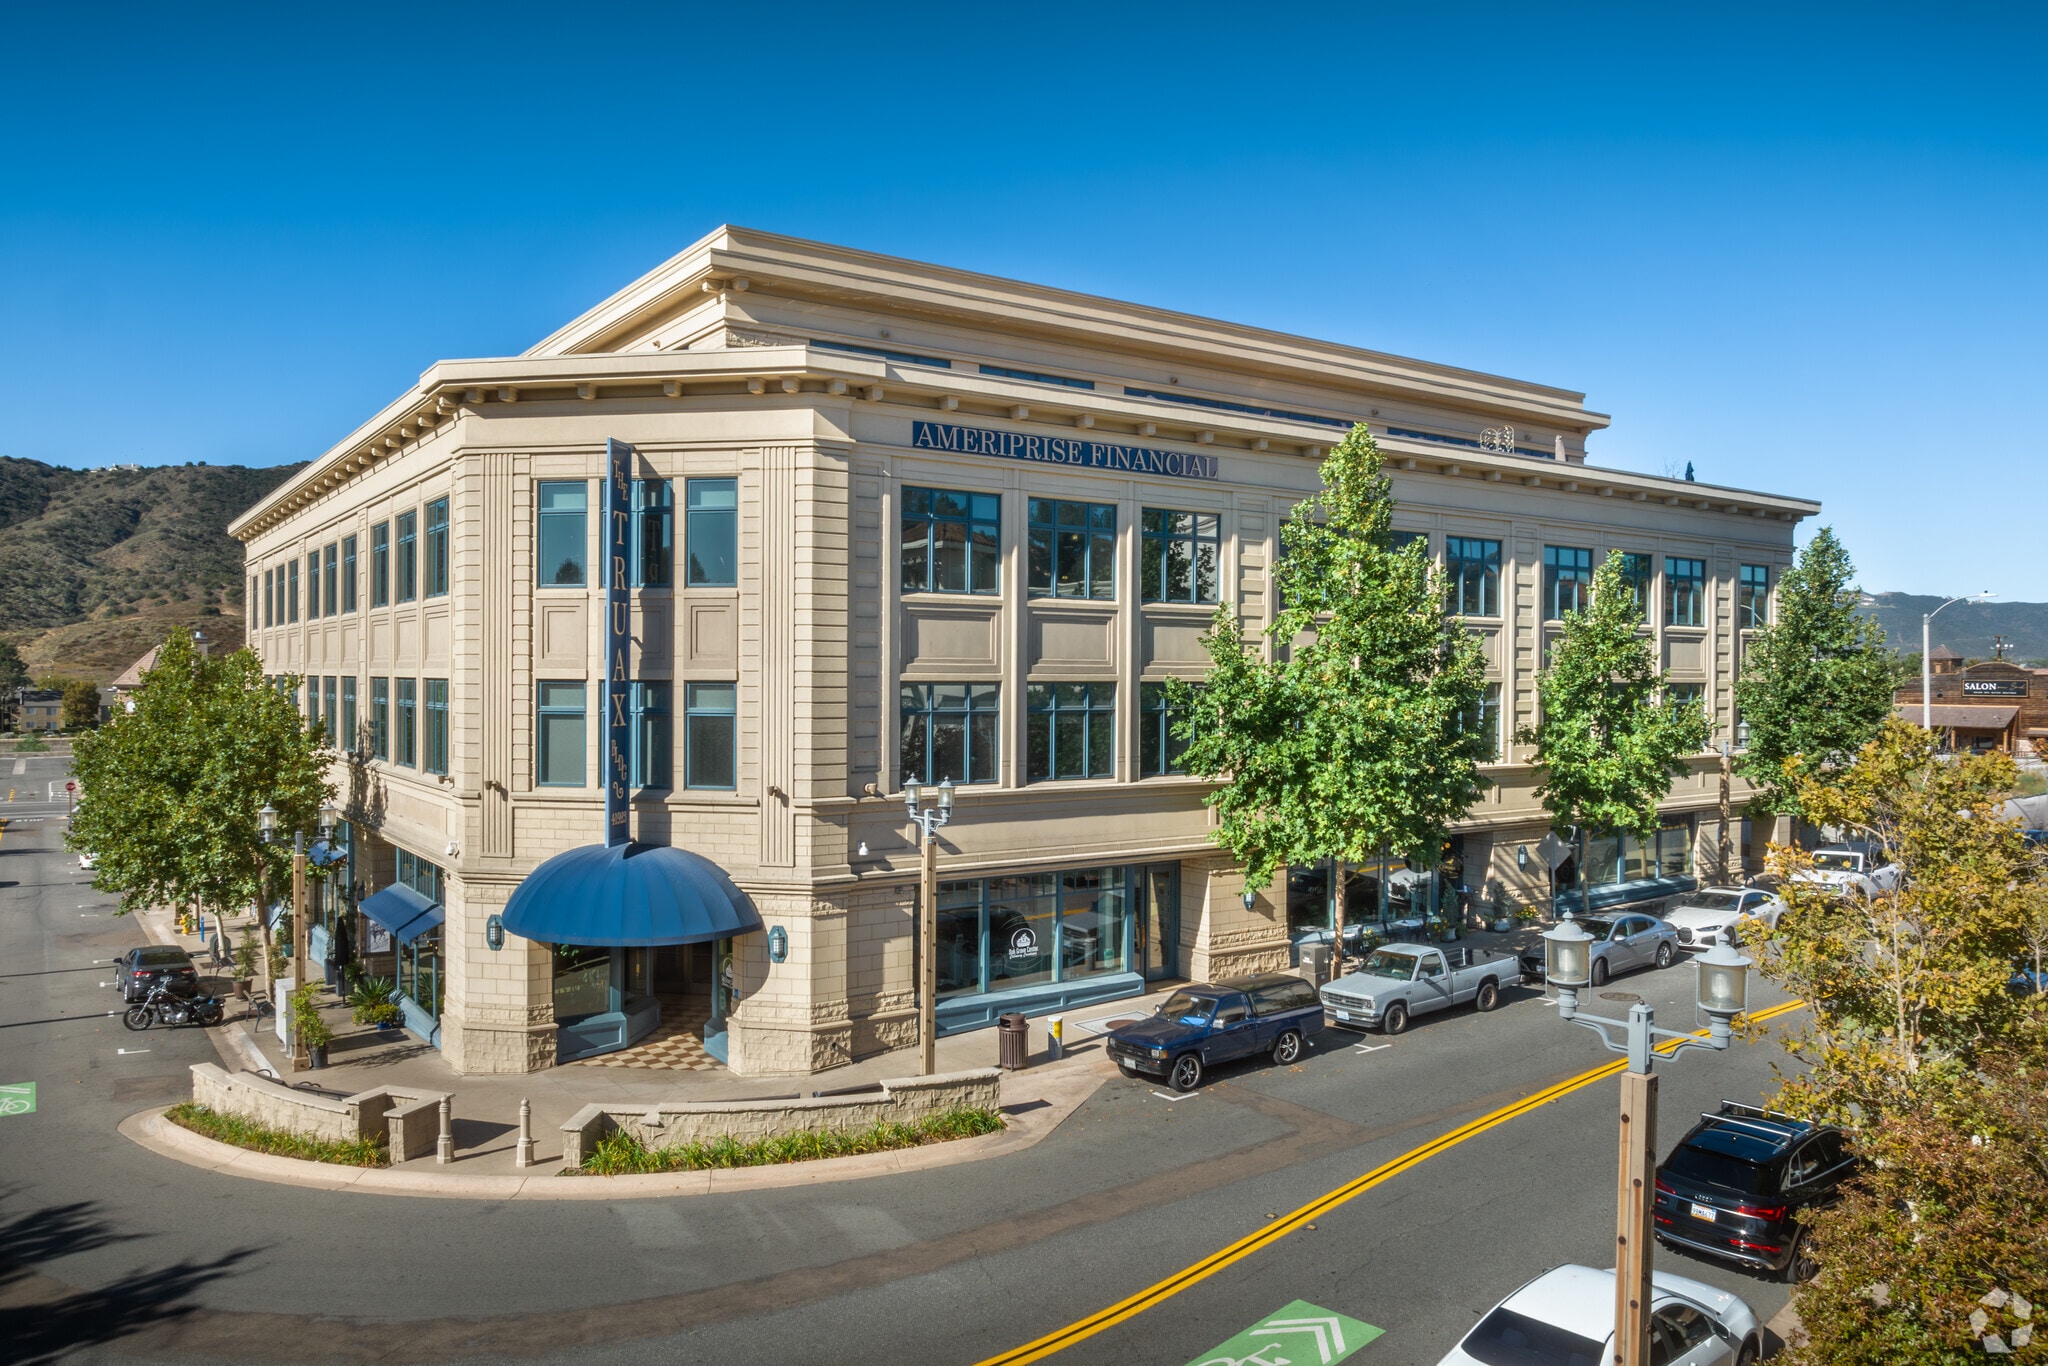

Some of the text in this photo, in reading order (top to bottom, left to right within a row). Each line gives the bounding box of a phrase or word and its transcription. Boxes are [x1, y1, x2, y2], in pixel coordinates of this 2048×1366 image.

[915, 423, 1218, 479] AMERIPRISE FINANCIAL
[613, 459, 629, 501] THE
[611, 510, 629, 727] TRUAX
[1964, 682, 1997, 690] SALON
[611, 739, 628, 781] BLDG
